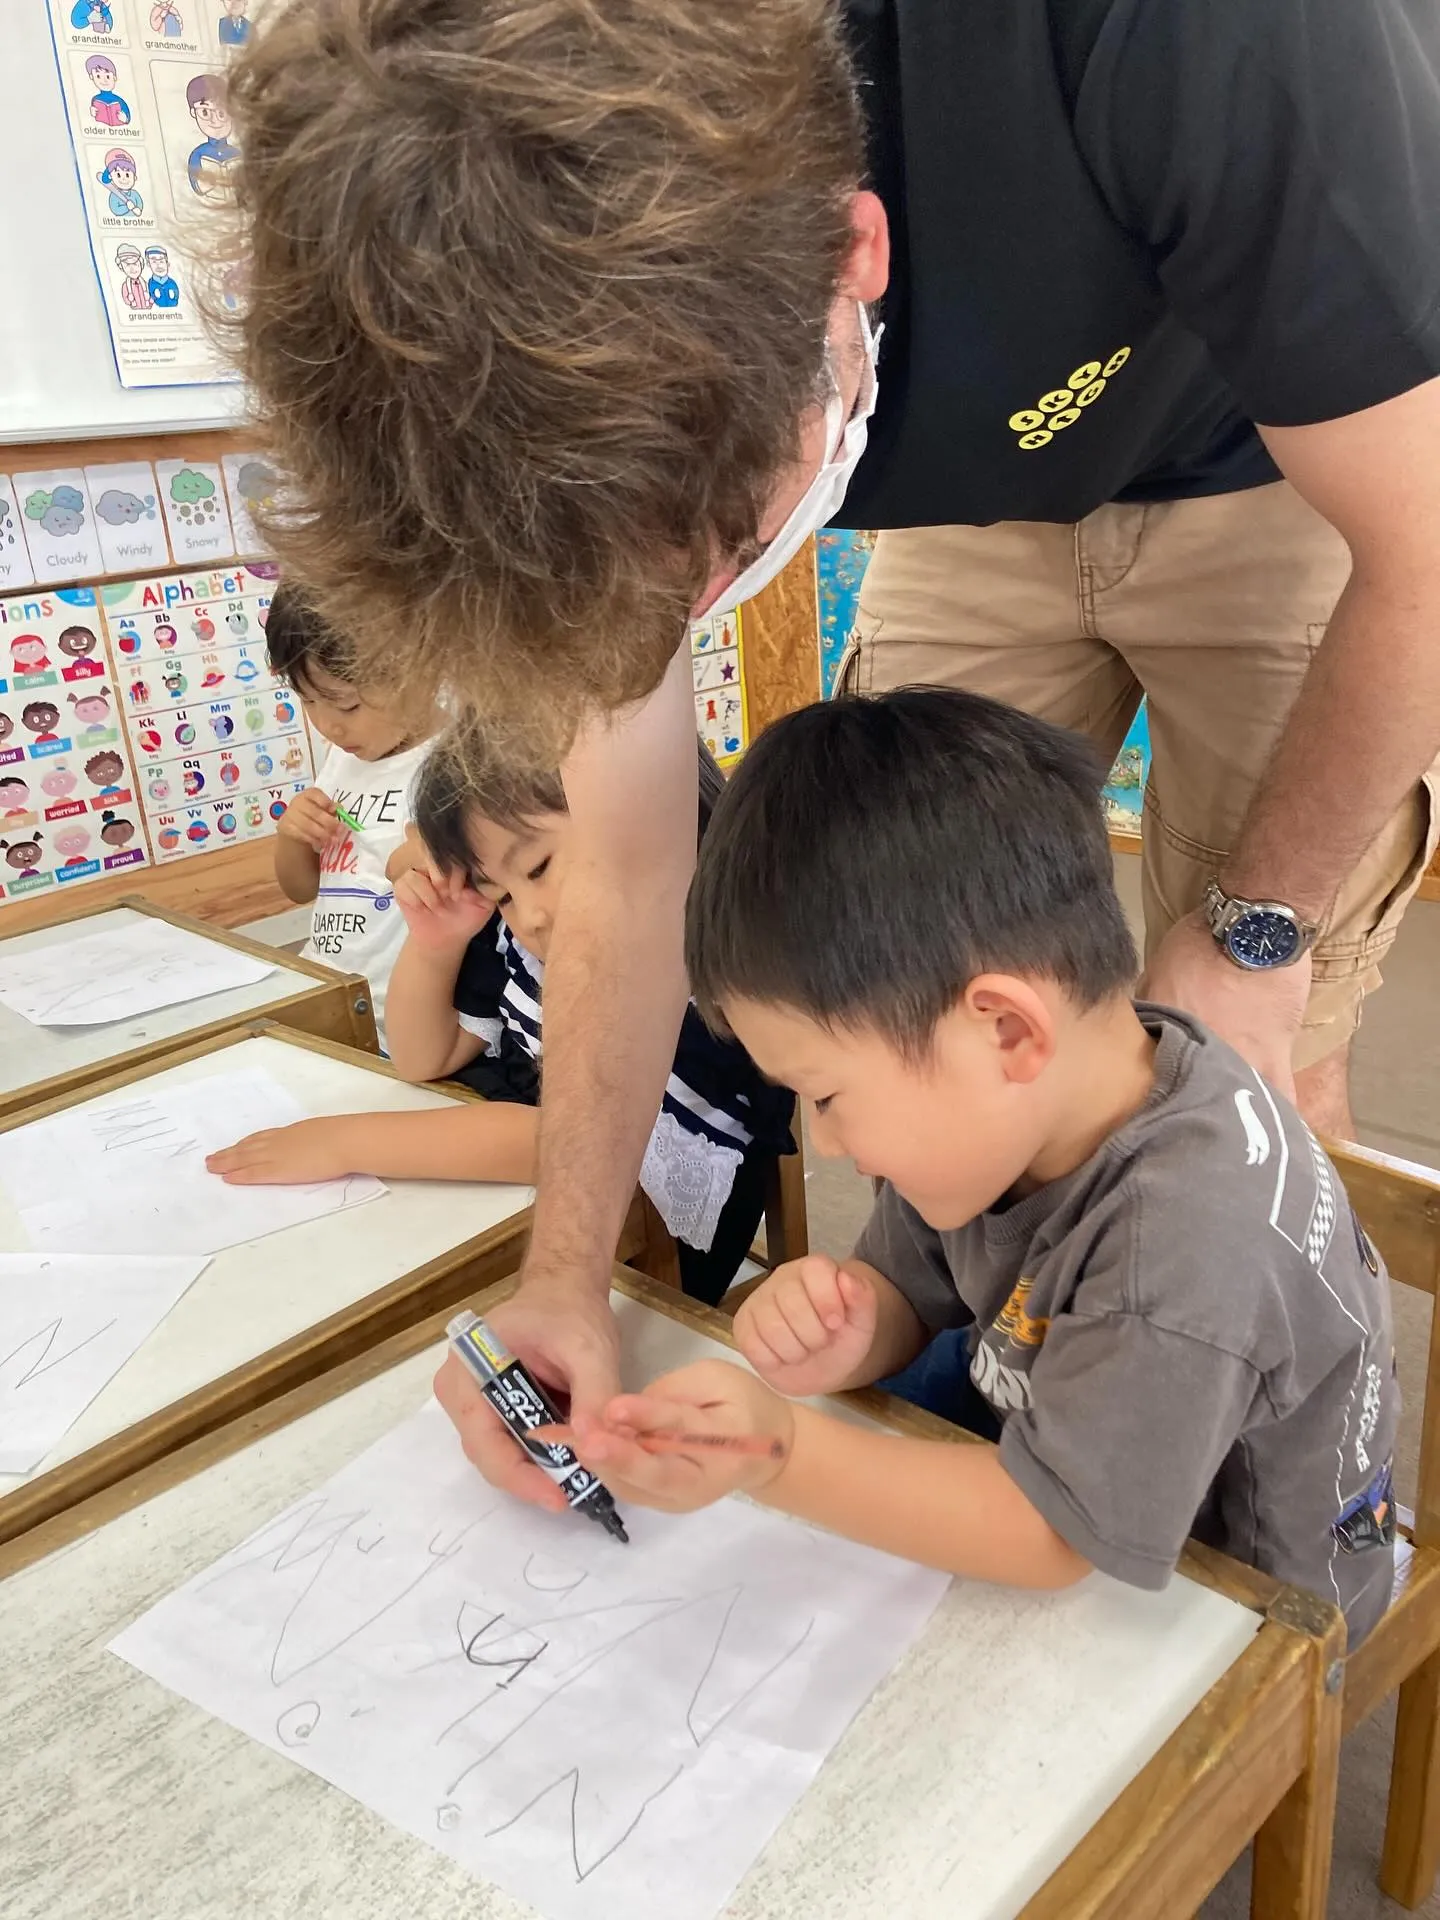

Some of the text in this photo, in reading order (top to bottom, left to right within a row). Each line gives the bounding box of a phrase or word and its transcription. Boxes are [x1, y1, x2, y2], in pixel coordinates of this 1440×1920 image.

[72, 34, 122, 45] grandfather
[145, 40, 198, 51] grandmother
[84, 127, 140, 136] older brother
[103, 217, 154, 226] little brother
[128, 312, 184, 321] grandparents
[116, 544, 153, 557] Windy
[185, 536, 219, 549] Snowy
[46, 552, 88, 567] Cloudy
[143, 571, 245, 608] Alphabet
[0, 599, 54, 623] ions
[119, 598, 271, 629] Aa Bb Cc Dd Ee
[166, 661, 182, 671] Gg
[202, 654, 218, 664] Hh
[139, 718, 156, 728] Kk
[210, 703, 231, 713] Mm
[275, 691, 289, 700] Oo
[148, 767, 163, 777] Pp
[183, 759, 201, 770] Qq
[220, 752, 233, 761] Rr
[49, 804, 80, 818] worried
[159, 816, 175, 826] Uu
[187, 809, 202, 818] Vv
[213, 802, 234, 812] Ww
[268, 790, 283, 800] Yy
[333, 787, 402, 825] KATE
[111, 854, 134, 867] proud
[59, 862, 97, 879] confident
[313, 913, 366, 933] UARTER
[492, 1389, 511, 1412] PILOT
